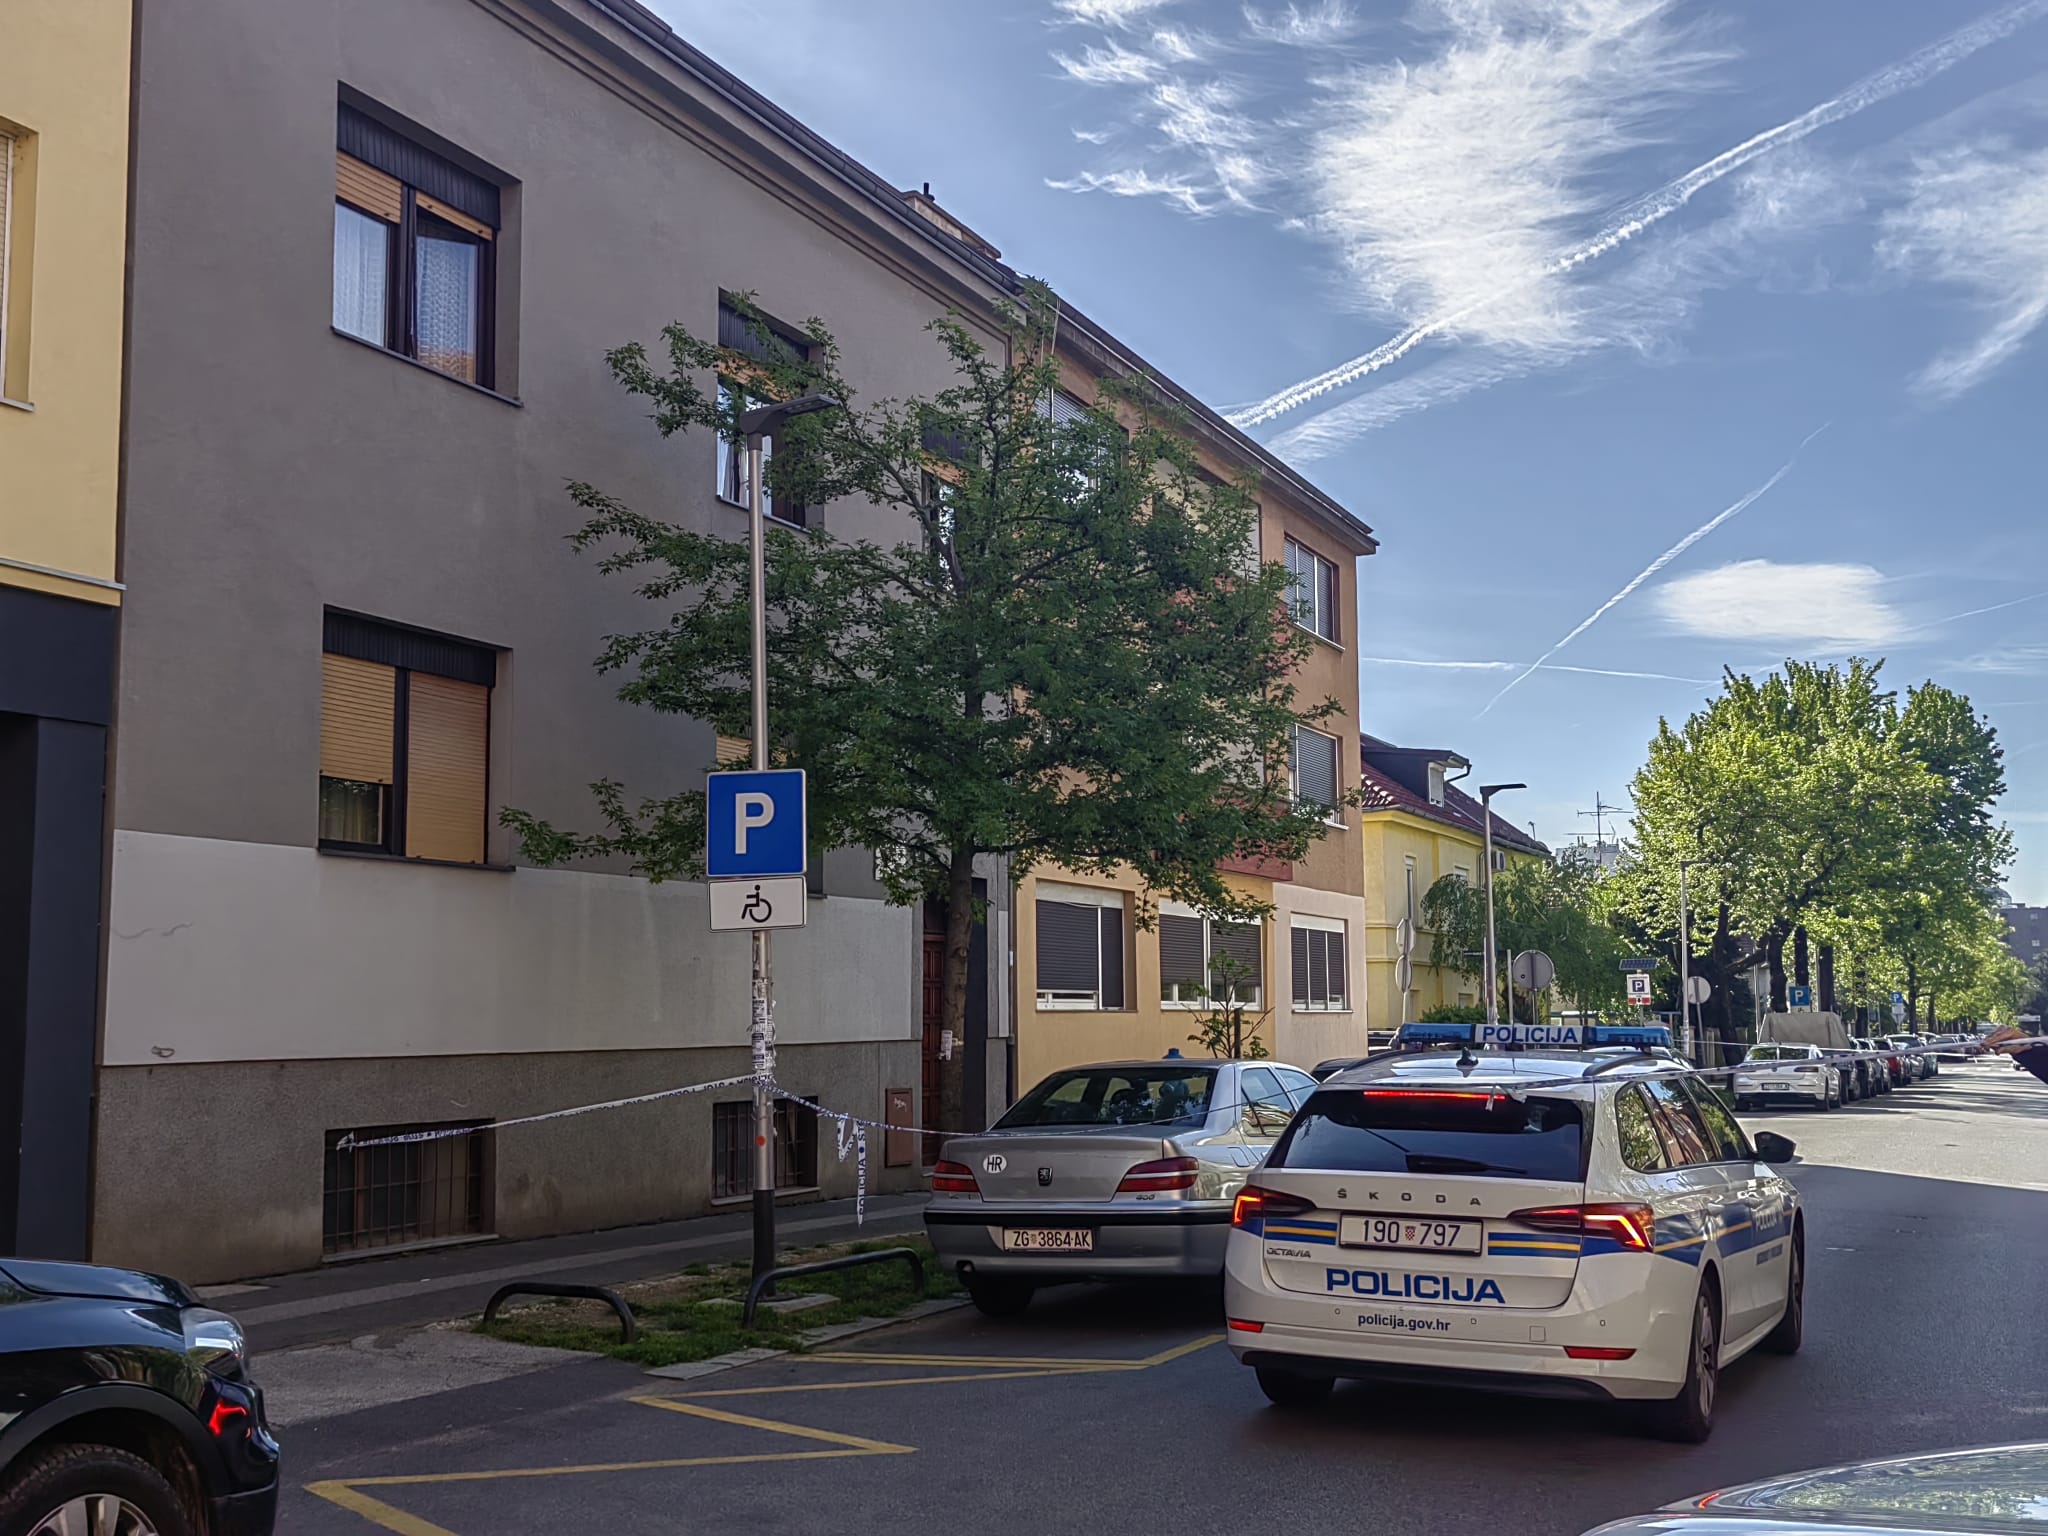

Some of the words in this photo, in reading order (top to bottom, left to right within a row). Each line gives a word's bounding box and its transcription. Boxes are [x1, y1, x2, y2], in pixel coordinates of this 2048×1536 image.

[735, 792, 775, 854] P
[1634, 981, 1643, 991] P
[1795, 990, 1804, 1003] P
[1482, 1026, 1578, 1043] POLICIJA
[986, 1156, 1003, 1172] HR
[1337, 1188, 1482, 1206] ŠKODA
[1013, 1231, 1030, 1247] ZG
[1363, 1219, 1400, 1243] 190
[1419, 1222, 1461, 1247] 797
[1266, 1247, 1311, 1258] OCTAVIA
[1326, 1267, 1506, 1304] POLICIJA
[1357, 1313, 1451, 1332] policija.gov.hr
